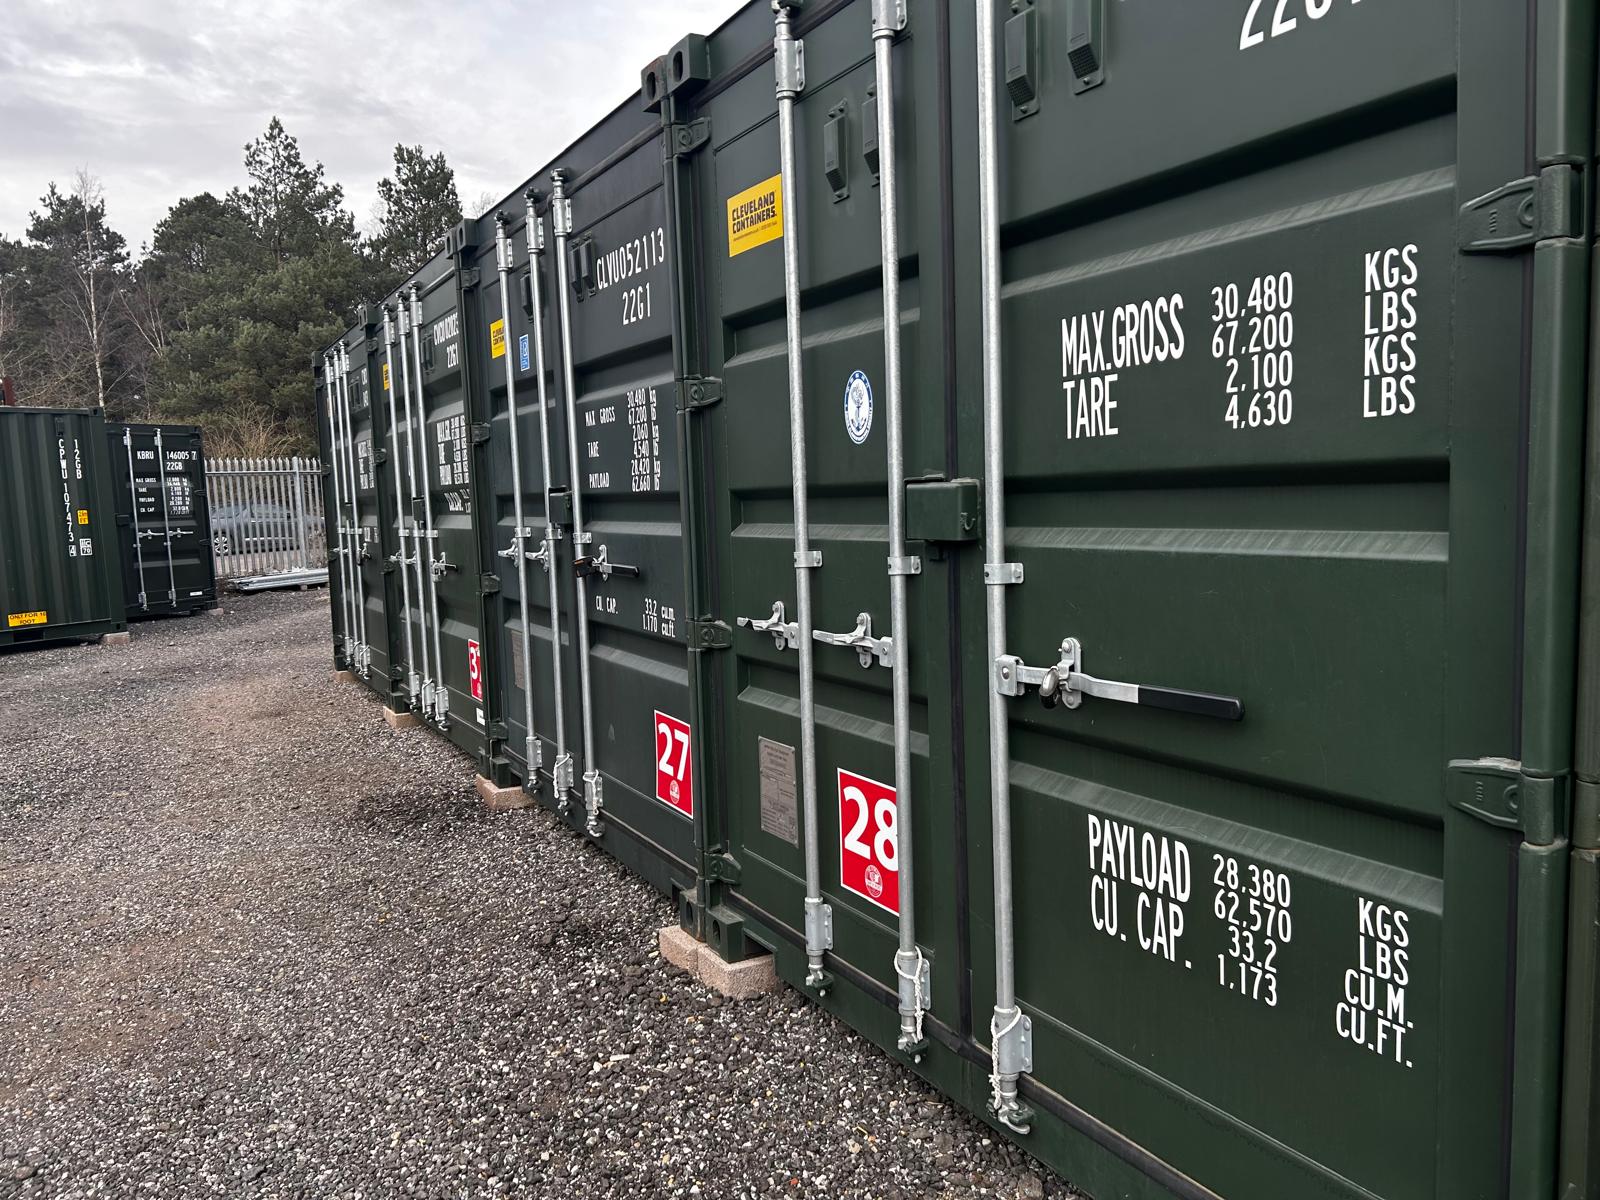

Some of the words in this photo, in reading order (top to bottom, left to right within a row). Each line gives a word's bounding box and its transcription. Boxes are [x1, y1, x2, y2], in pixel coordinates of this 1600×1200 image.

[732, 190, 776, 222] CLEVELAND
[1364, 243, 1419, 293] KGS
[622, 282, 650, 325] 22G1
[1364, 287, 1418, 336] LBS
[585, 410, 596, 427] MAX
[599, 406, 616, 424] GROSS
[649, 386, 657, 407] kg
[1062, 373, 1118, 440] TARE
[1363, 331, 1417, 377] KGS
[1362, 374, 1416, 418] LBS
[137, 451, 154, 459] KBRU
[166, 451, 190, 459] 146005
[588, 441, 600, 458] TARE
[652, 421, 659, 442] kg
[58, 438, 68, 479] CPWU
[63, 482, 75, 542] 107473
[589, 472, 610, 489] PAYLOAD
[653, 457, 661, 478] kg
[596, 595, 604, 611] CU.
[606, 597, 619, 614] CAP.
[645, 597, 658, 616] 33.2
[658, 722, 689, 782] 27
[843, 786, 899, 872] 28
[1087, 813, 1191, 903] PAYLOAD
[1358, 897, 1409, 948] KGS
[1091, 874, 1127, 942] CU.
[1137, 891, 1192, 970] CAP.
[1228, 925, 1278, 974] 33.2
[1344, 968, 1414, 1029] CU.M.
[1359, 935, 1409, 986] LBS
[1335, 1001, 1413, 1069] CU.FT.
